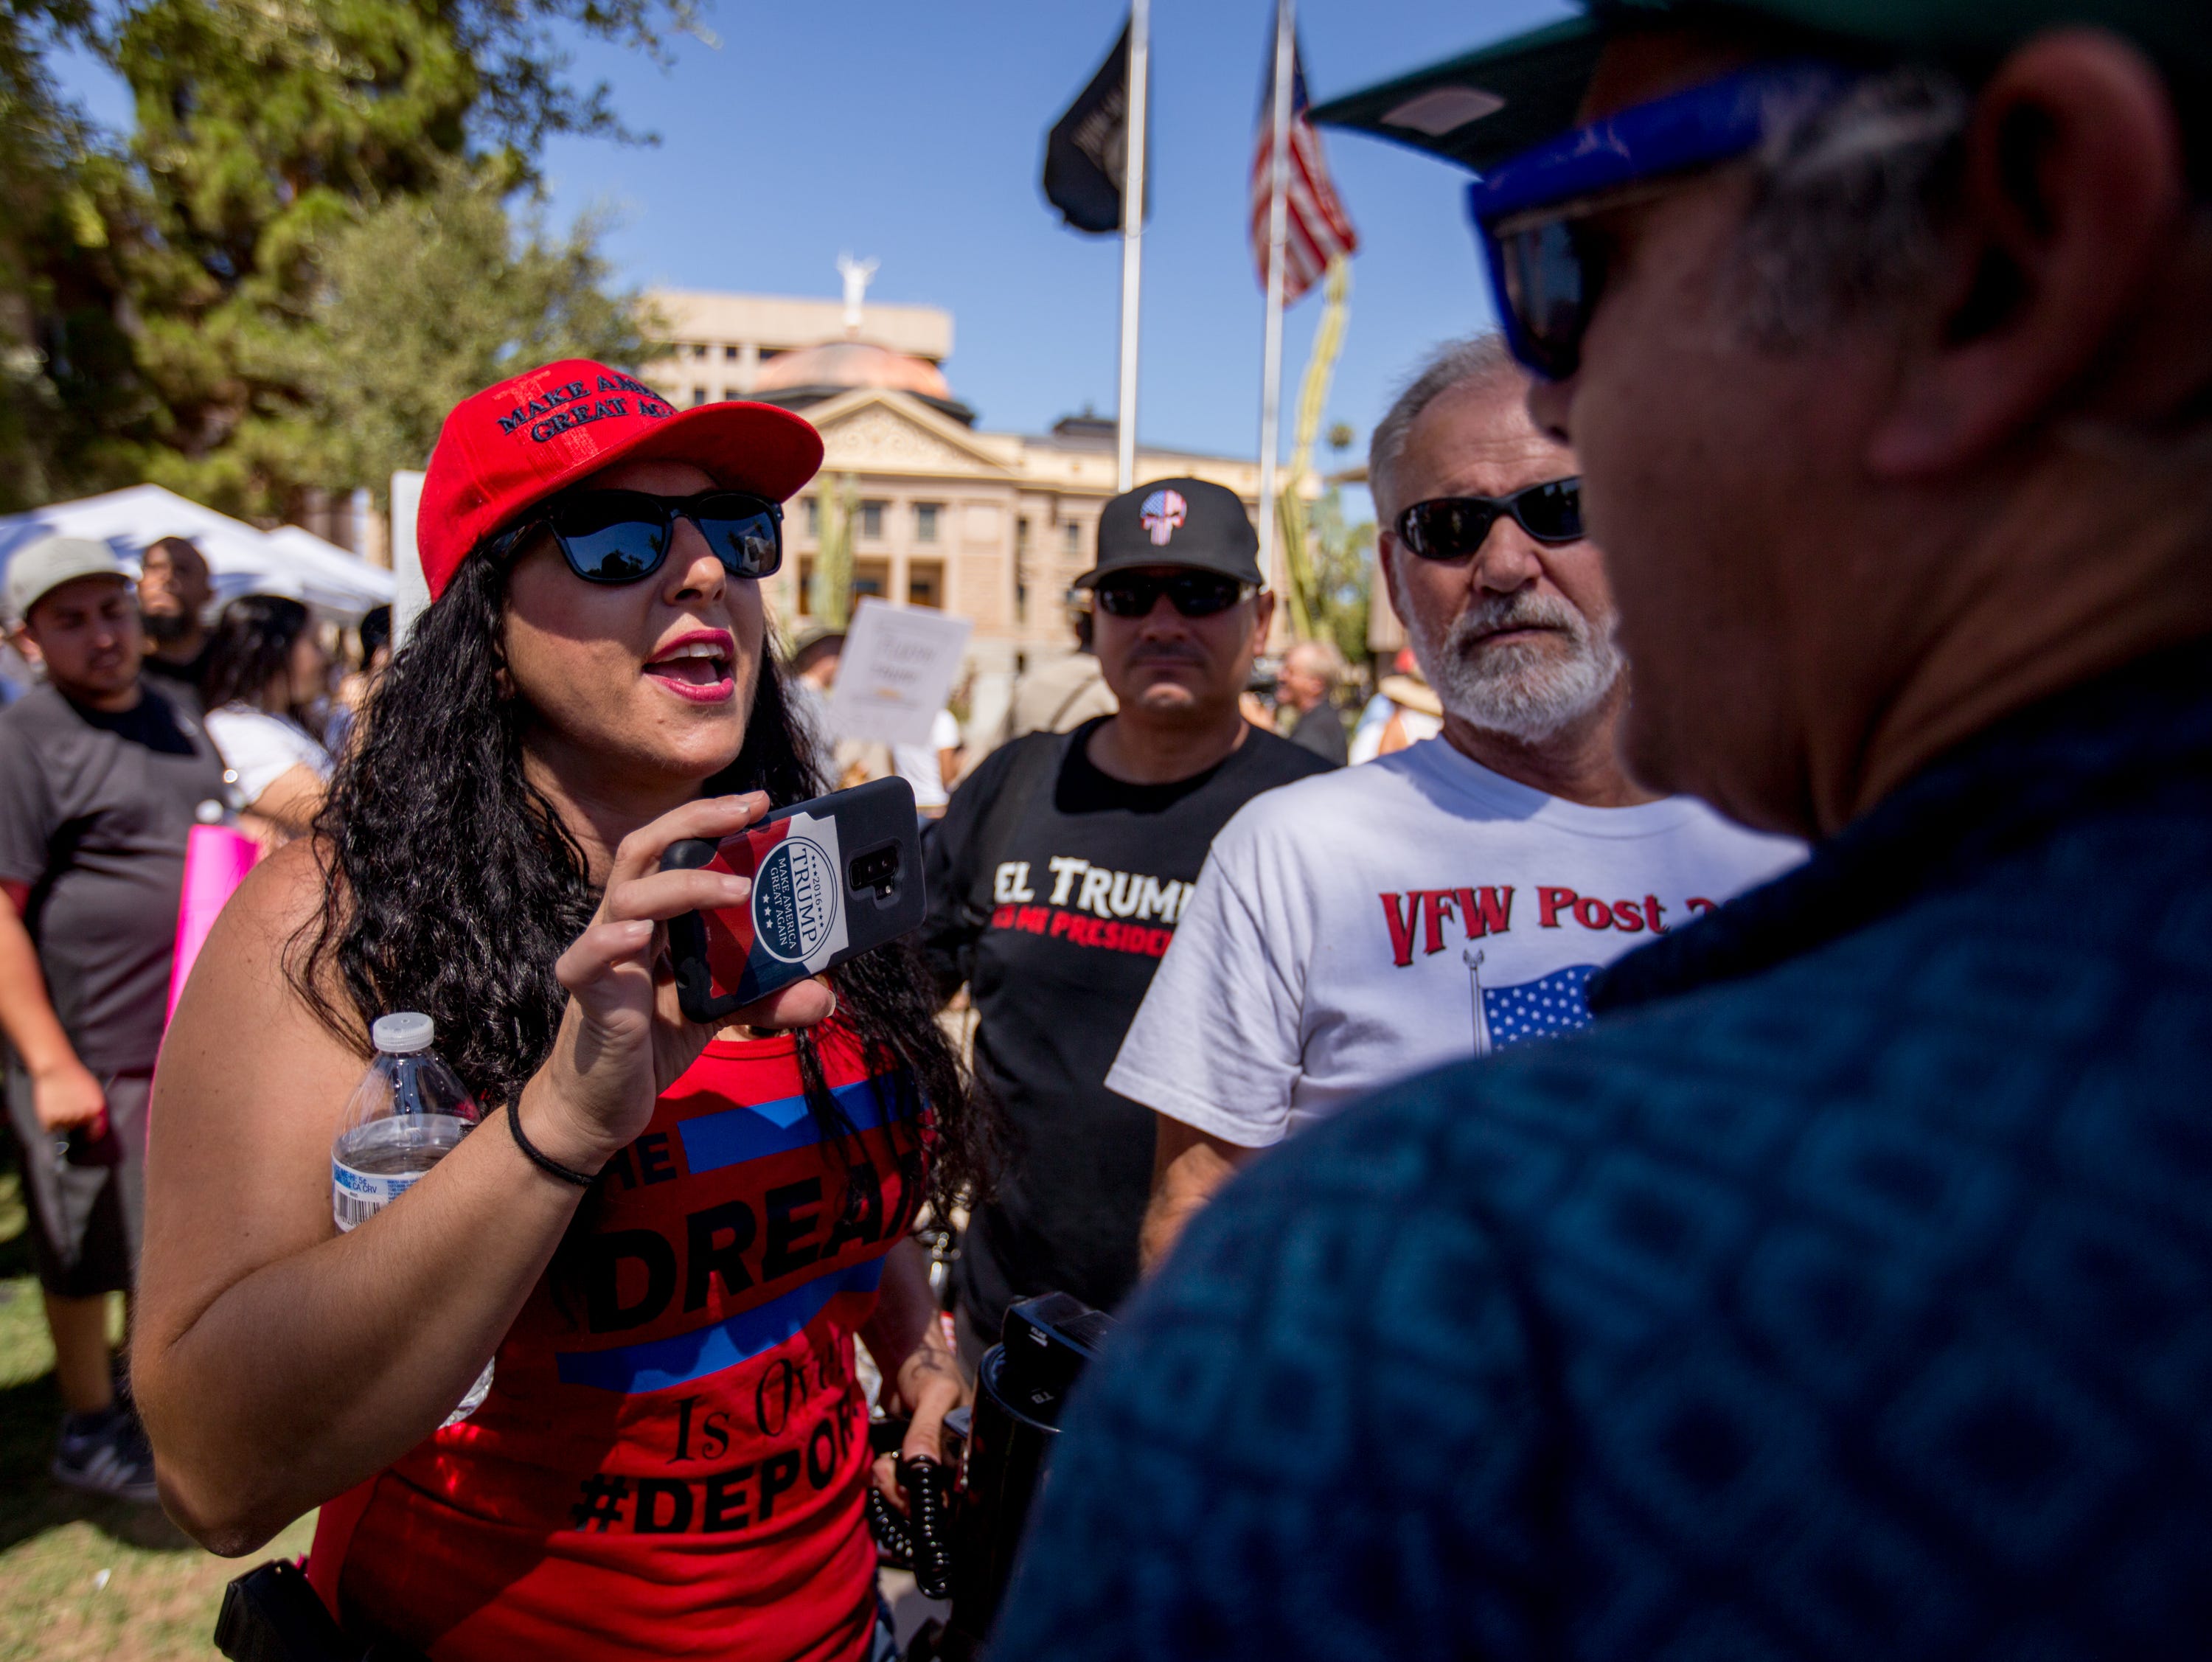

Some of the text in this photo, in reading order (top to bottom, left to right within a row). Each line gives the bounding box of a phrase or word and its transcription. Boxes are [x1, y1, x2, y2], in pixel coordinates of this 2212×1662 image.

[496, 379, 591, 435] MAKE
[530, 397, 629, 443] GREAT
[770, 866, 788, 946] GREAT AGAIN
[778, 856, 798, 950] MAKE AMERICA
[793, 847, 818, 942] TRUMP
[813, 876, 824, 906] 2016
[995, 860, 1035, 904] EL
[1378, 885, 1672, 967] VFW Post
[352, 1182, 362, 1192] CA
[362, 1183, 378, 1194] CRV
[601, 1132, 677, 1189] HE
[571, 1388, 858, 1534] #DEPOR
[666, 1394, 731, 1465] Is
